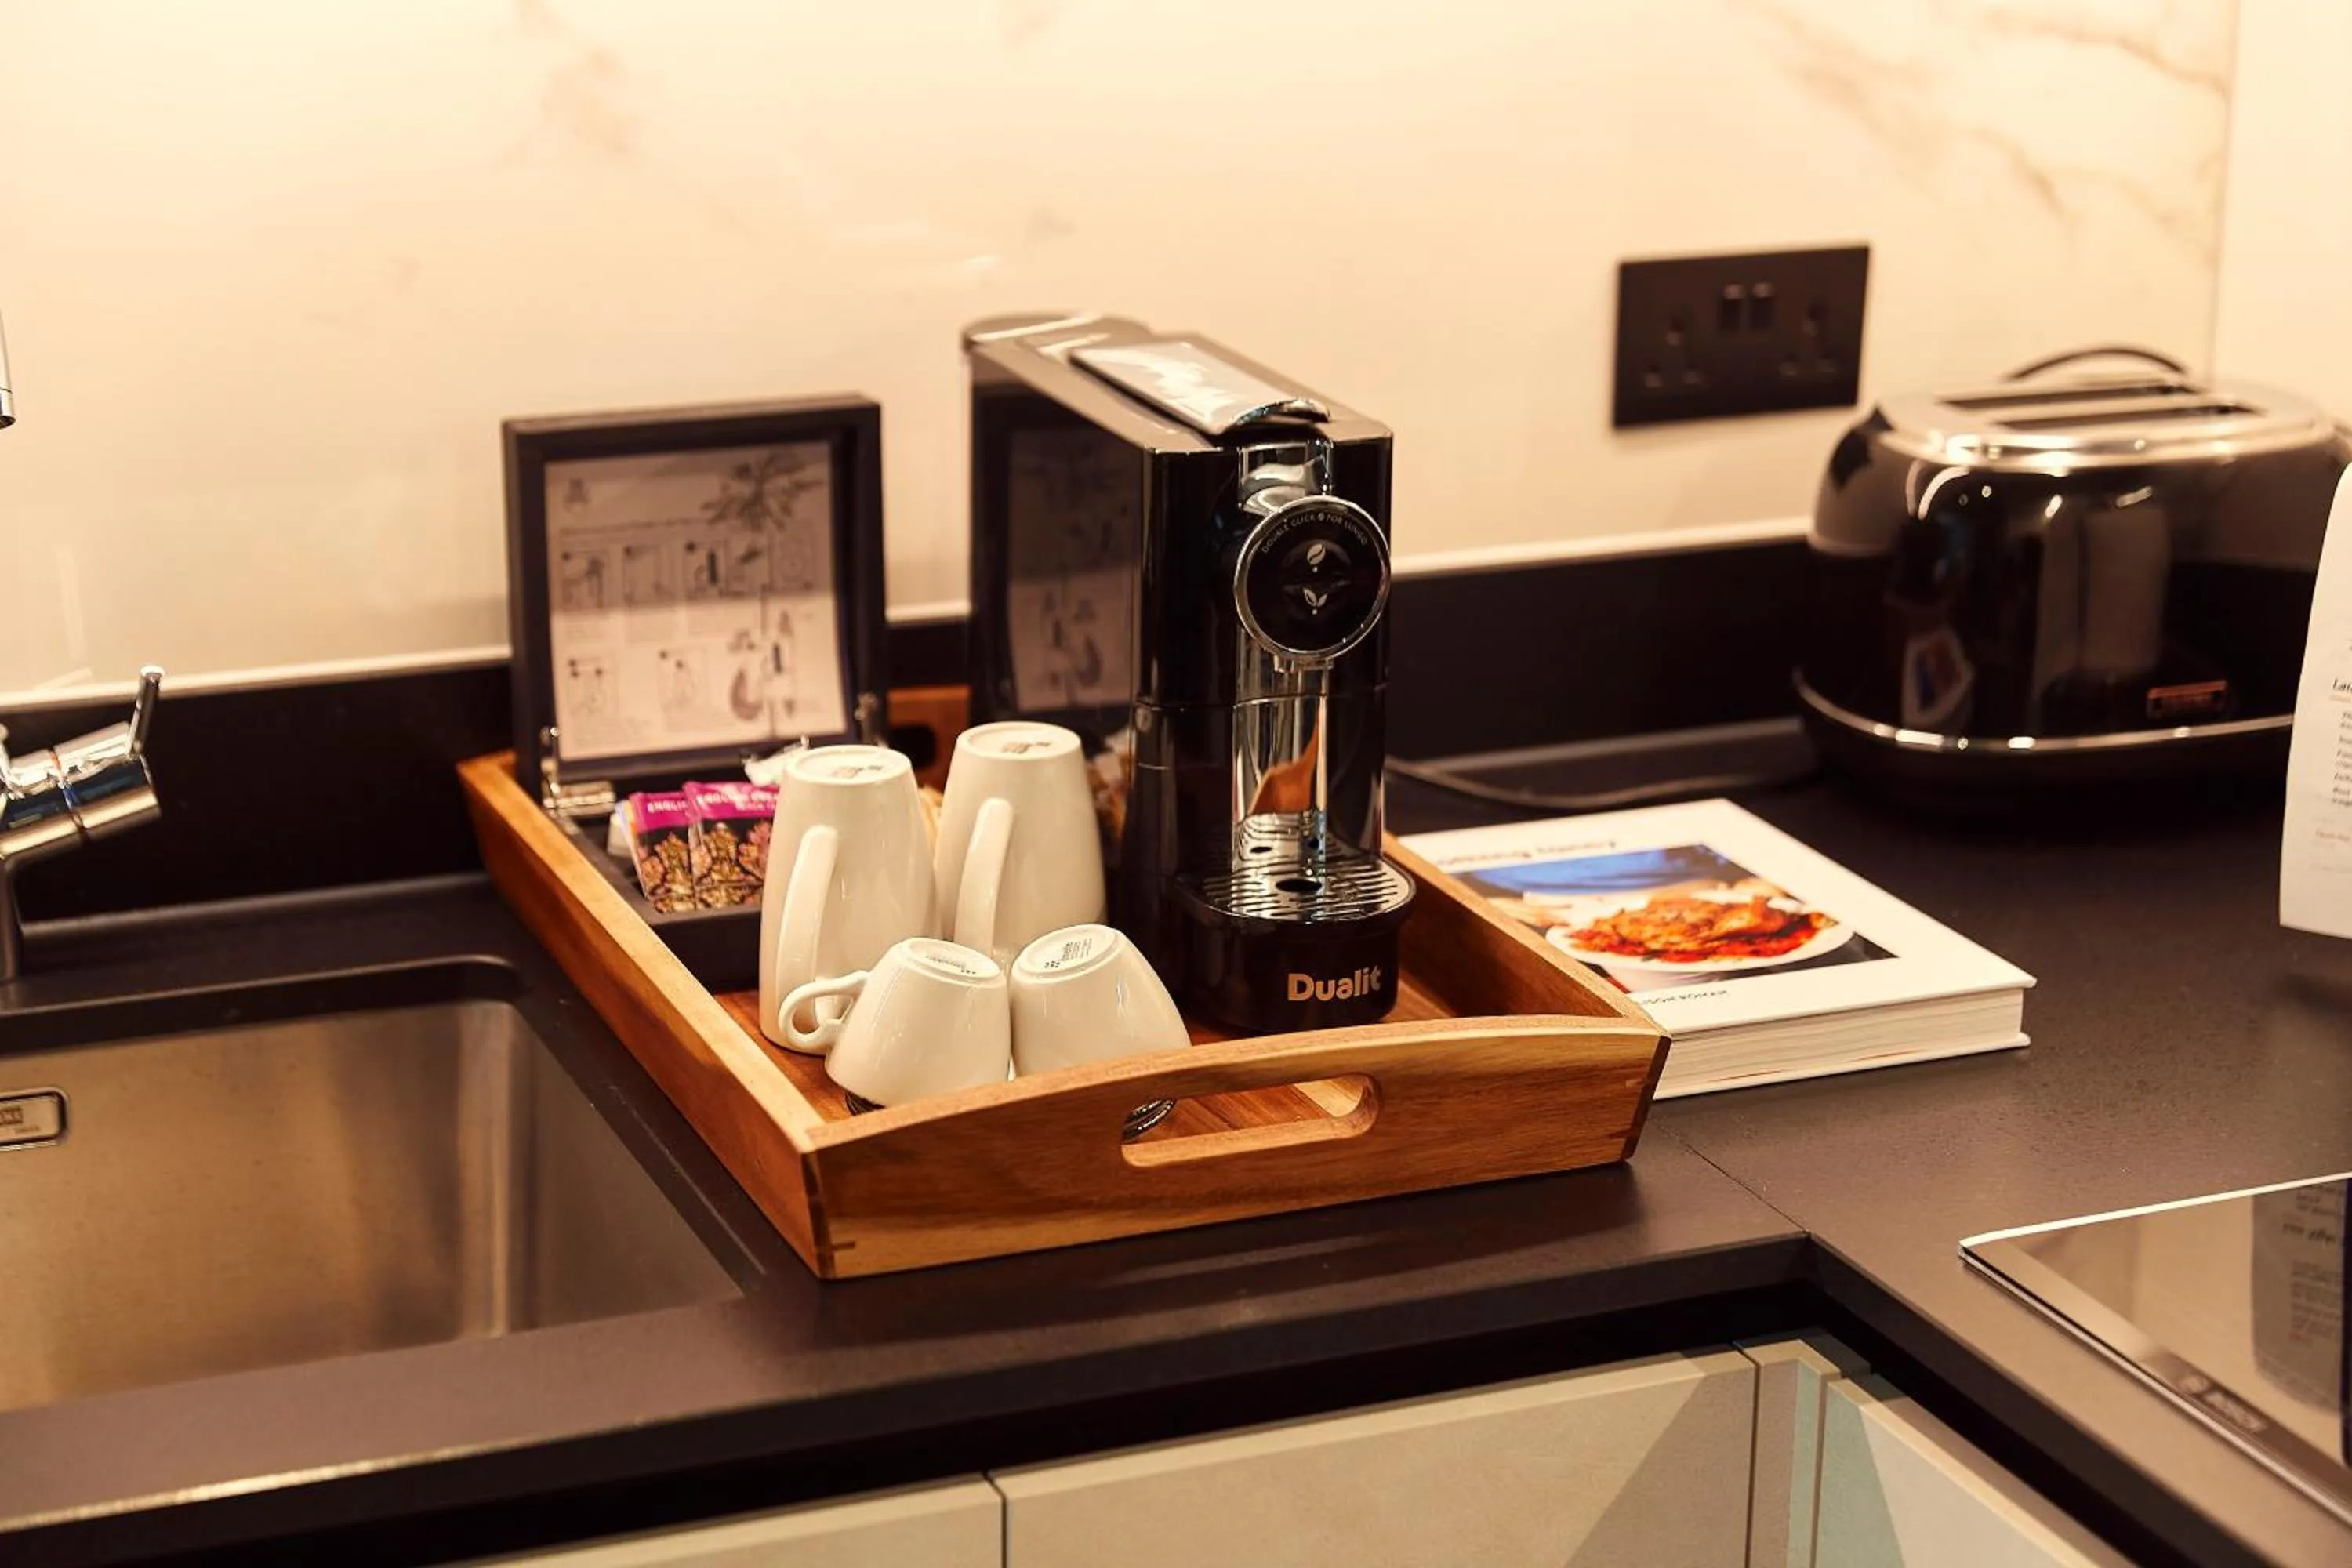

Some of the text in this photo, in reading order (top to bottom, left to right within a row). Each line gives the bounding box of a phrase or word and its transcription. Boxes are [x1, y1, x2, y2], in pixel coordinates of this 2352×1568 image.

[1261, 524, 1290, 554] DOUBLE
[1290, 514, 1315, 527] CLICK
[1326, 514, 1342, 524] FOR
[1287, 965, 1381, 1001] Dualit
